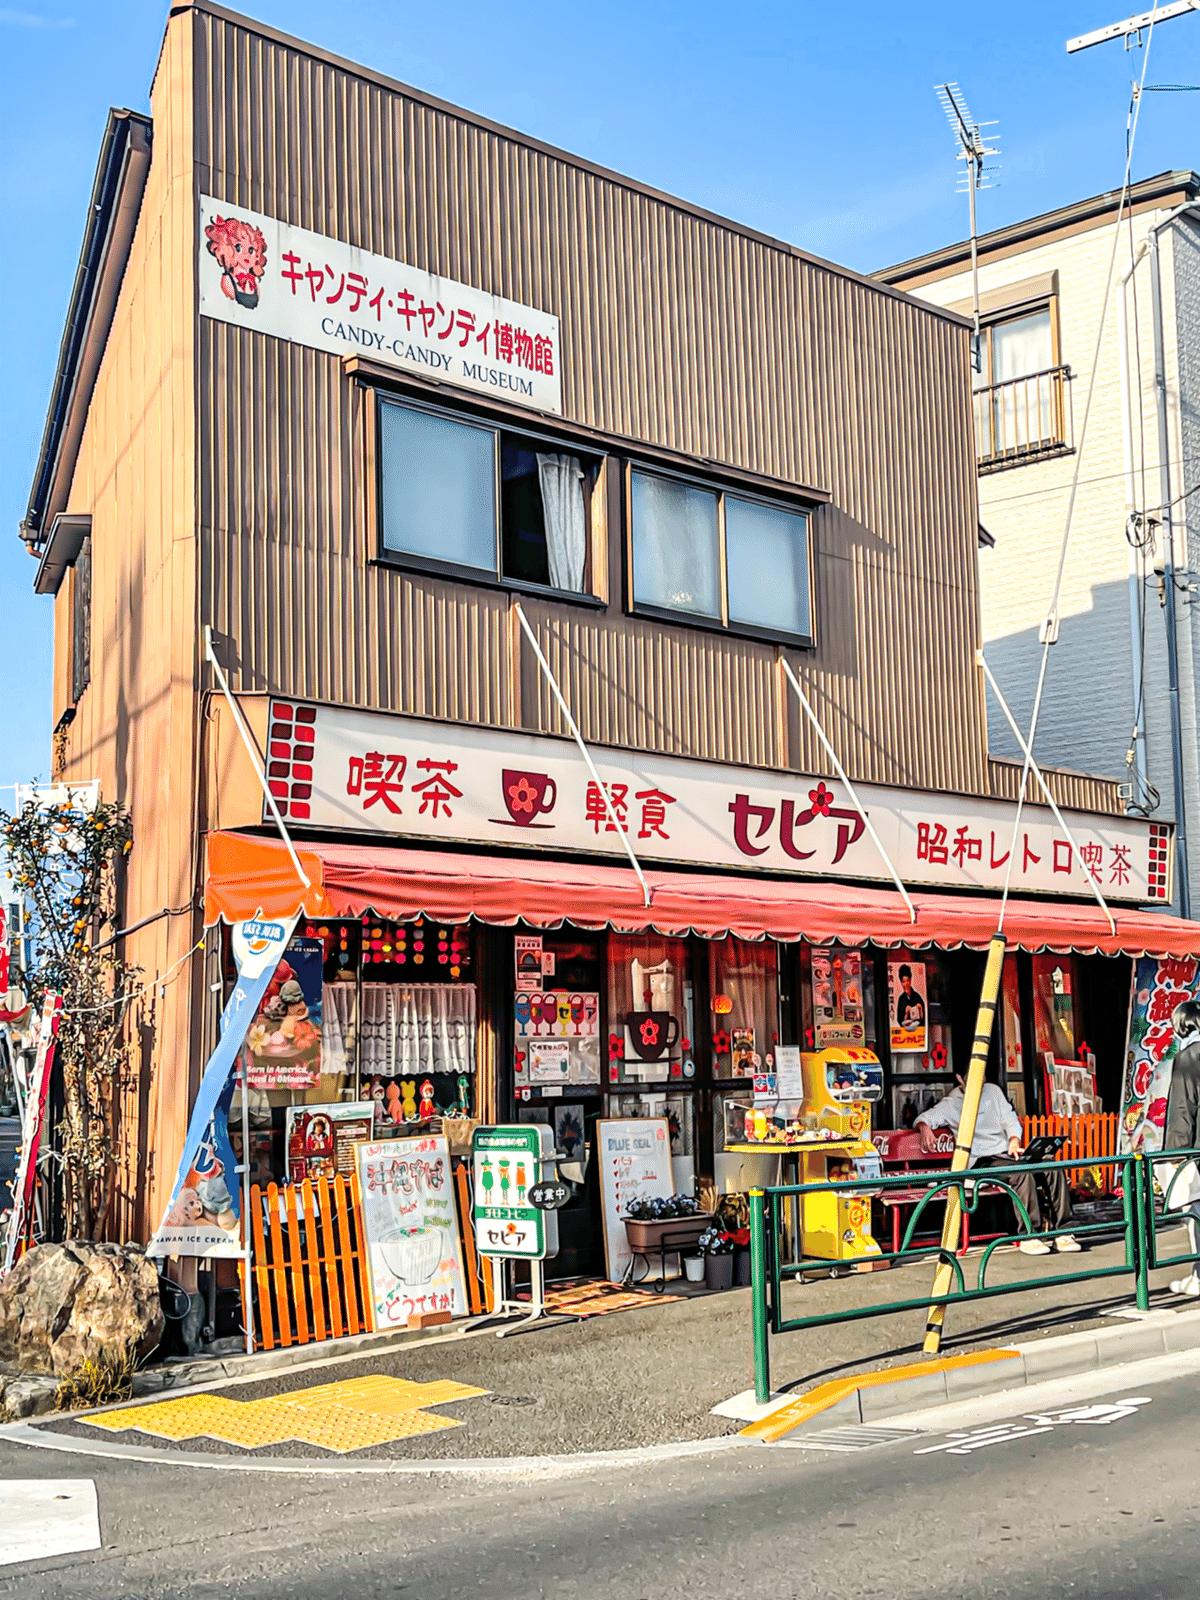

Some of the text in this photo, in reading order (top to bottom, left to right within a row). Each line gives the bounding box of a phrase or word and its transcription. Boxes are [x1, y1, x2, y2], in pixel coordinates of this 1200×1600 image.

[281, 250, 554, 376] キャンディ・キャンディ博物館
[321, 317, 533, 396] CANDY-CANDY MUSEUM
[347, 751, 1132, 887] 喫茶 軽食 セピア 昭和レトロ喫茶
[486, 1221, 527, 1247] セピア
[533, 1187, 565, 1202] 営業中
